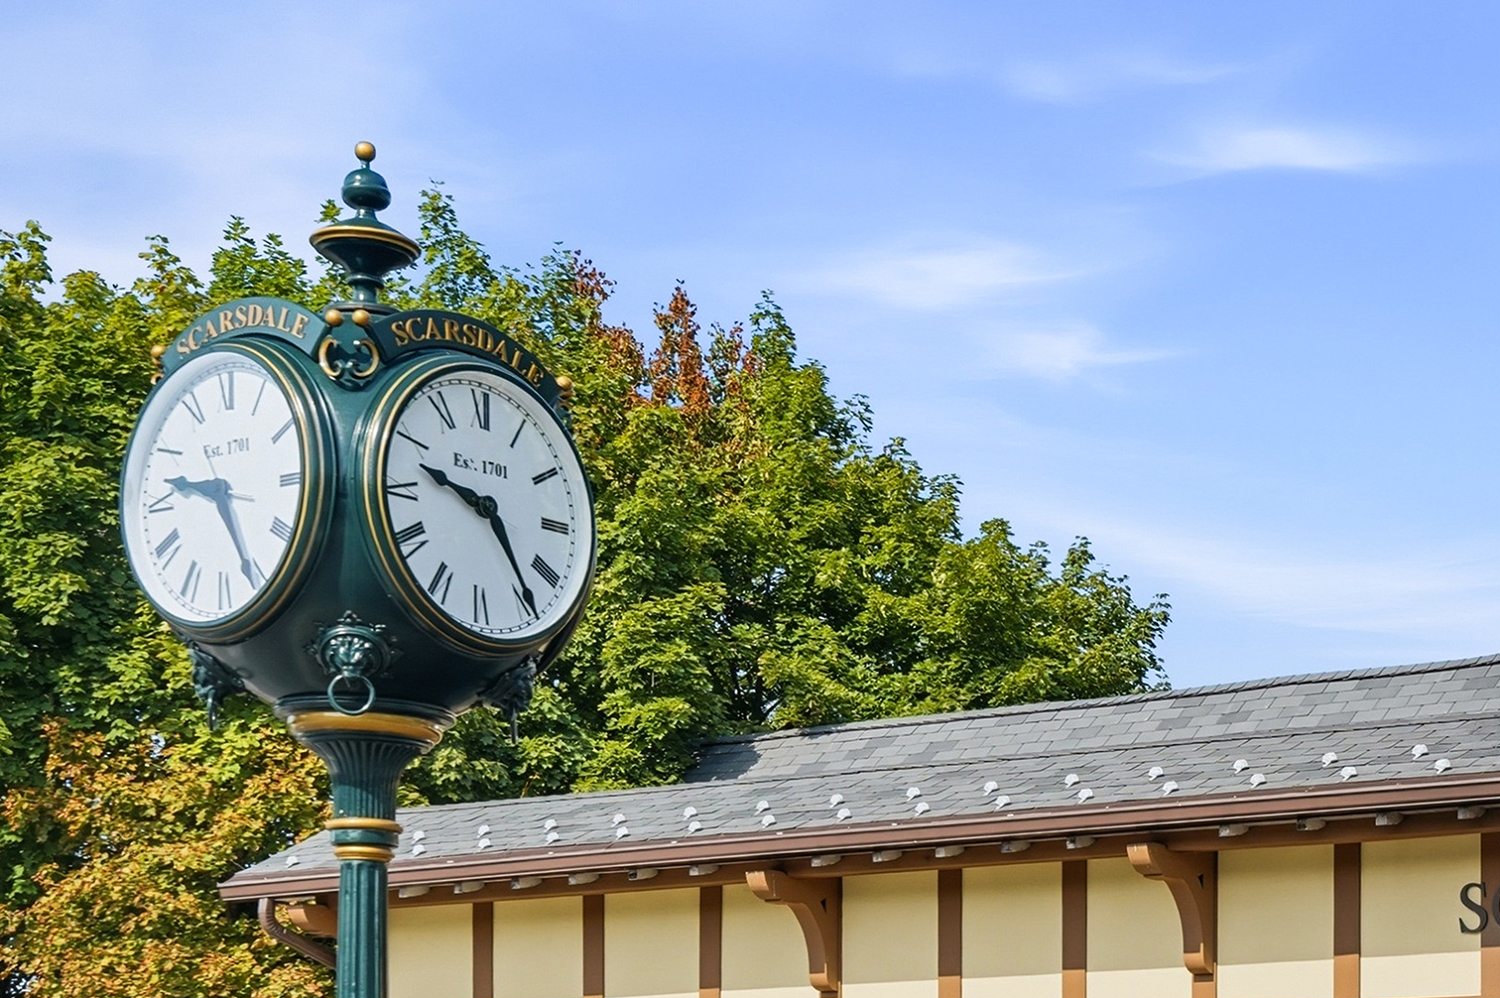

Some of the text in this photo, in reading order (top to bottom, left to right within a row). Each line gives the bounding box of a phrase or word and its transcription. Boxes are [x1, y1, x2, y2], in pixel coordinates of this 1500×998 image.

[176, 303, 309, 355] SCARSDALE
[390, 317, 545, 388] SCARSDALE
[227, 438, 250, 455] 1701
[482, 460, 508, 480] 1701
